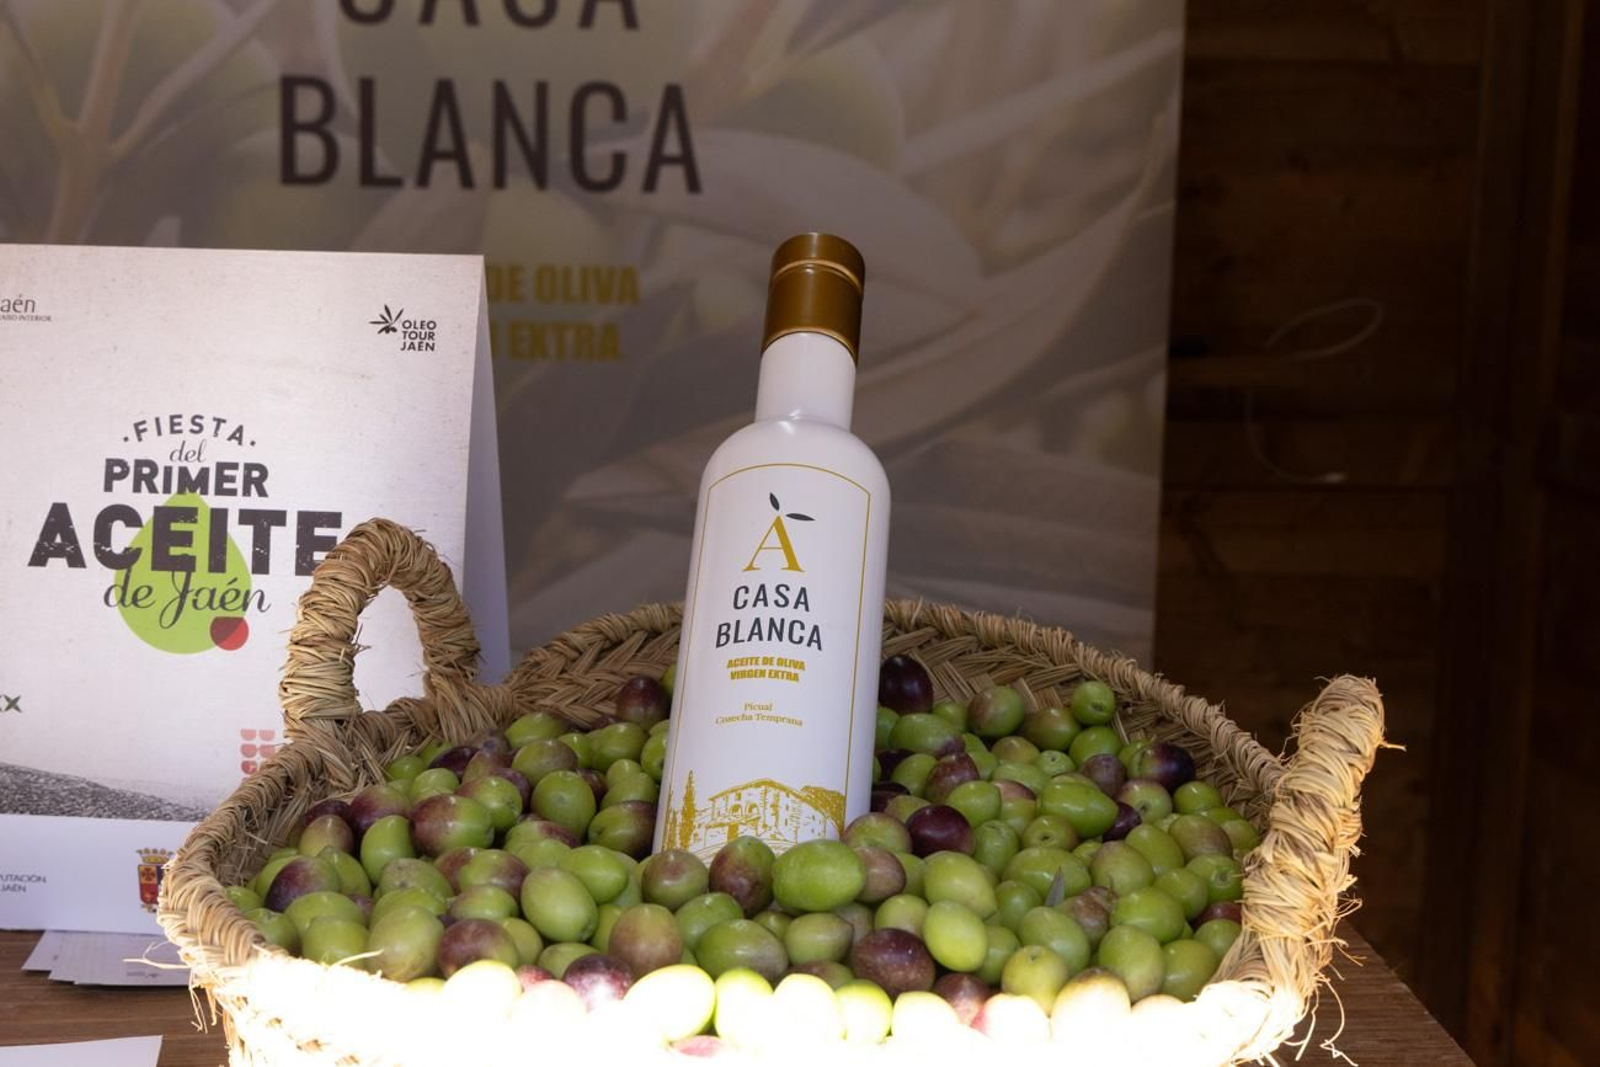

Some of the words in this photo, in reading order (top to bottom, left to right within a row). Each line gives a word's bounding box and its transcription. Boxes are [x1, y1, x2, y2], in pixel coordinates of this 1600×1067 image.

[279, 74, 703, 195] BLANCA
[534, 264, 640, 306] OLIVA
[0, 293, 36, 313] aén
[402, 319, 437, 330] OLEO
[402, 331, 435, 341] TOUR
[509, 321, 622, 361] EXTRA
[169, 440, 207, 463] del
[103, 458, 269, 498] PRIMER
[27, 502, 342, 577] ACEITE
[103, 562, 157, 609] de
[158, 570, 271, 629] Jaén
[732, 583, 810, 612] CASA
[715, 616, 823, 652] BLANCA
[727, 656, 760, 669] ACEITE
[761, 656, 775, 667] DE
[776, 657, 806, 671] OLIVA
[730, 668, 766, 681] VIRGEN
[767, 668, 800, 682] EXTRA
[743, 702, 773, 711] Picual
[715, 713, 753, 725] Cosecha
[755, 713, 803, 728] Temprana
